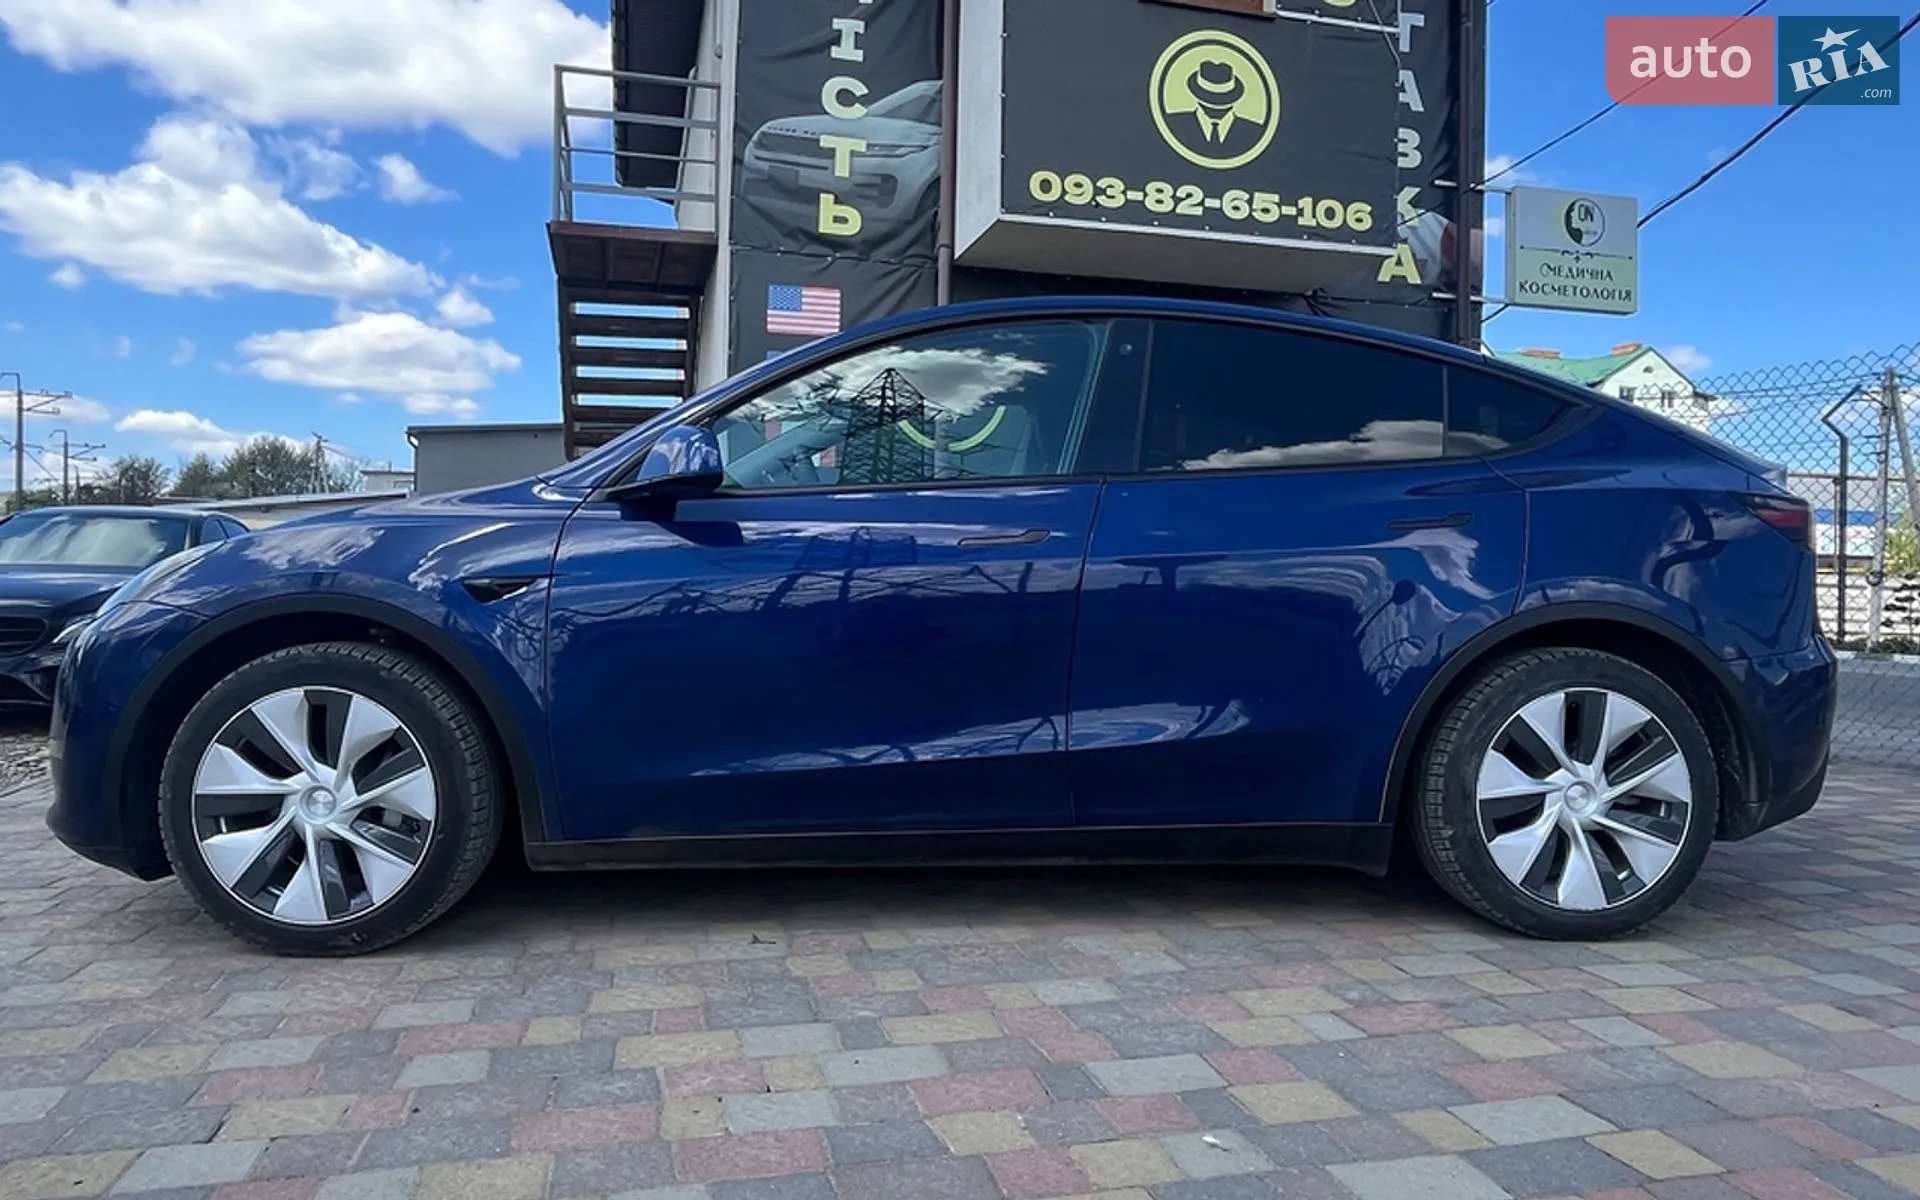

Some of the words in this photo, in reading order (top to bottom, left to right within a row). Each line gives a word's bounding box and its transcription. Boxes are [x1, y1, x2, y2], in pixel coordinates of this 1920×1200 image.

[817, 0, 876, 236] ІСТЬ
[1029, 170, 1373, 232] 093-82-65-106
[1519, 280, 1632, 302] КОСМЕТОЛОГІЯ
